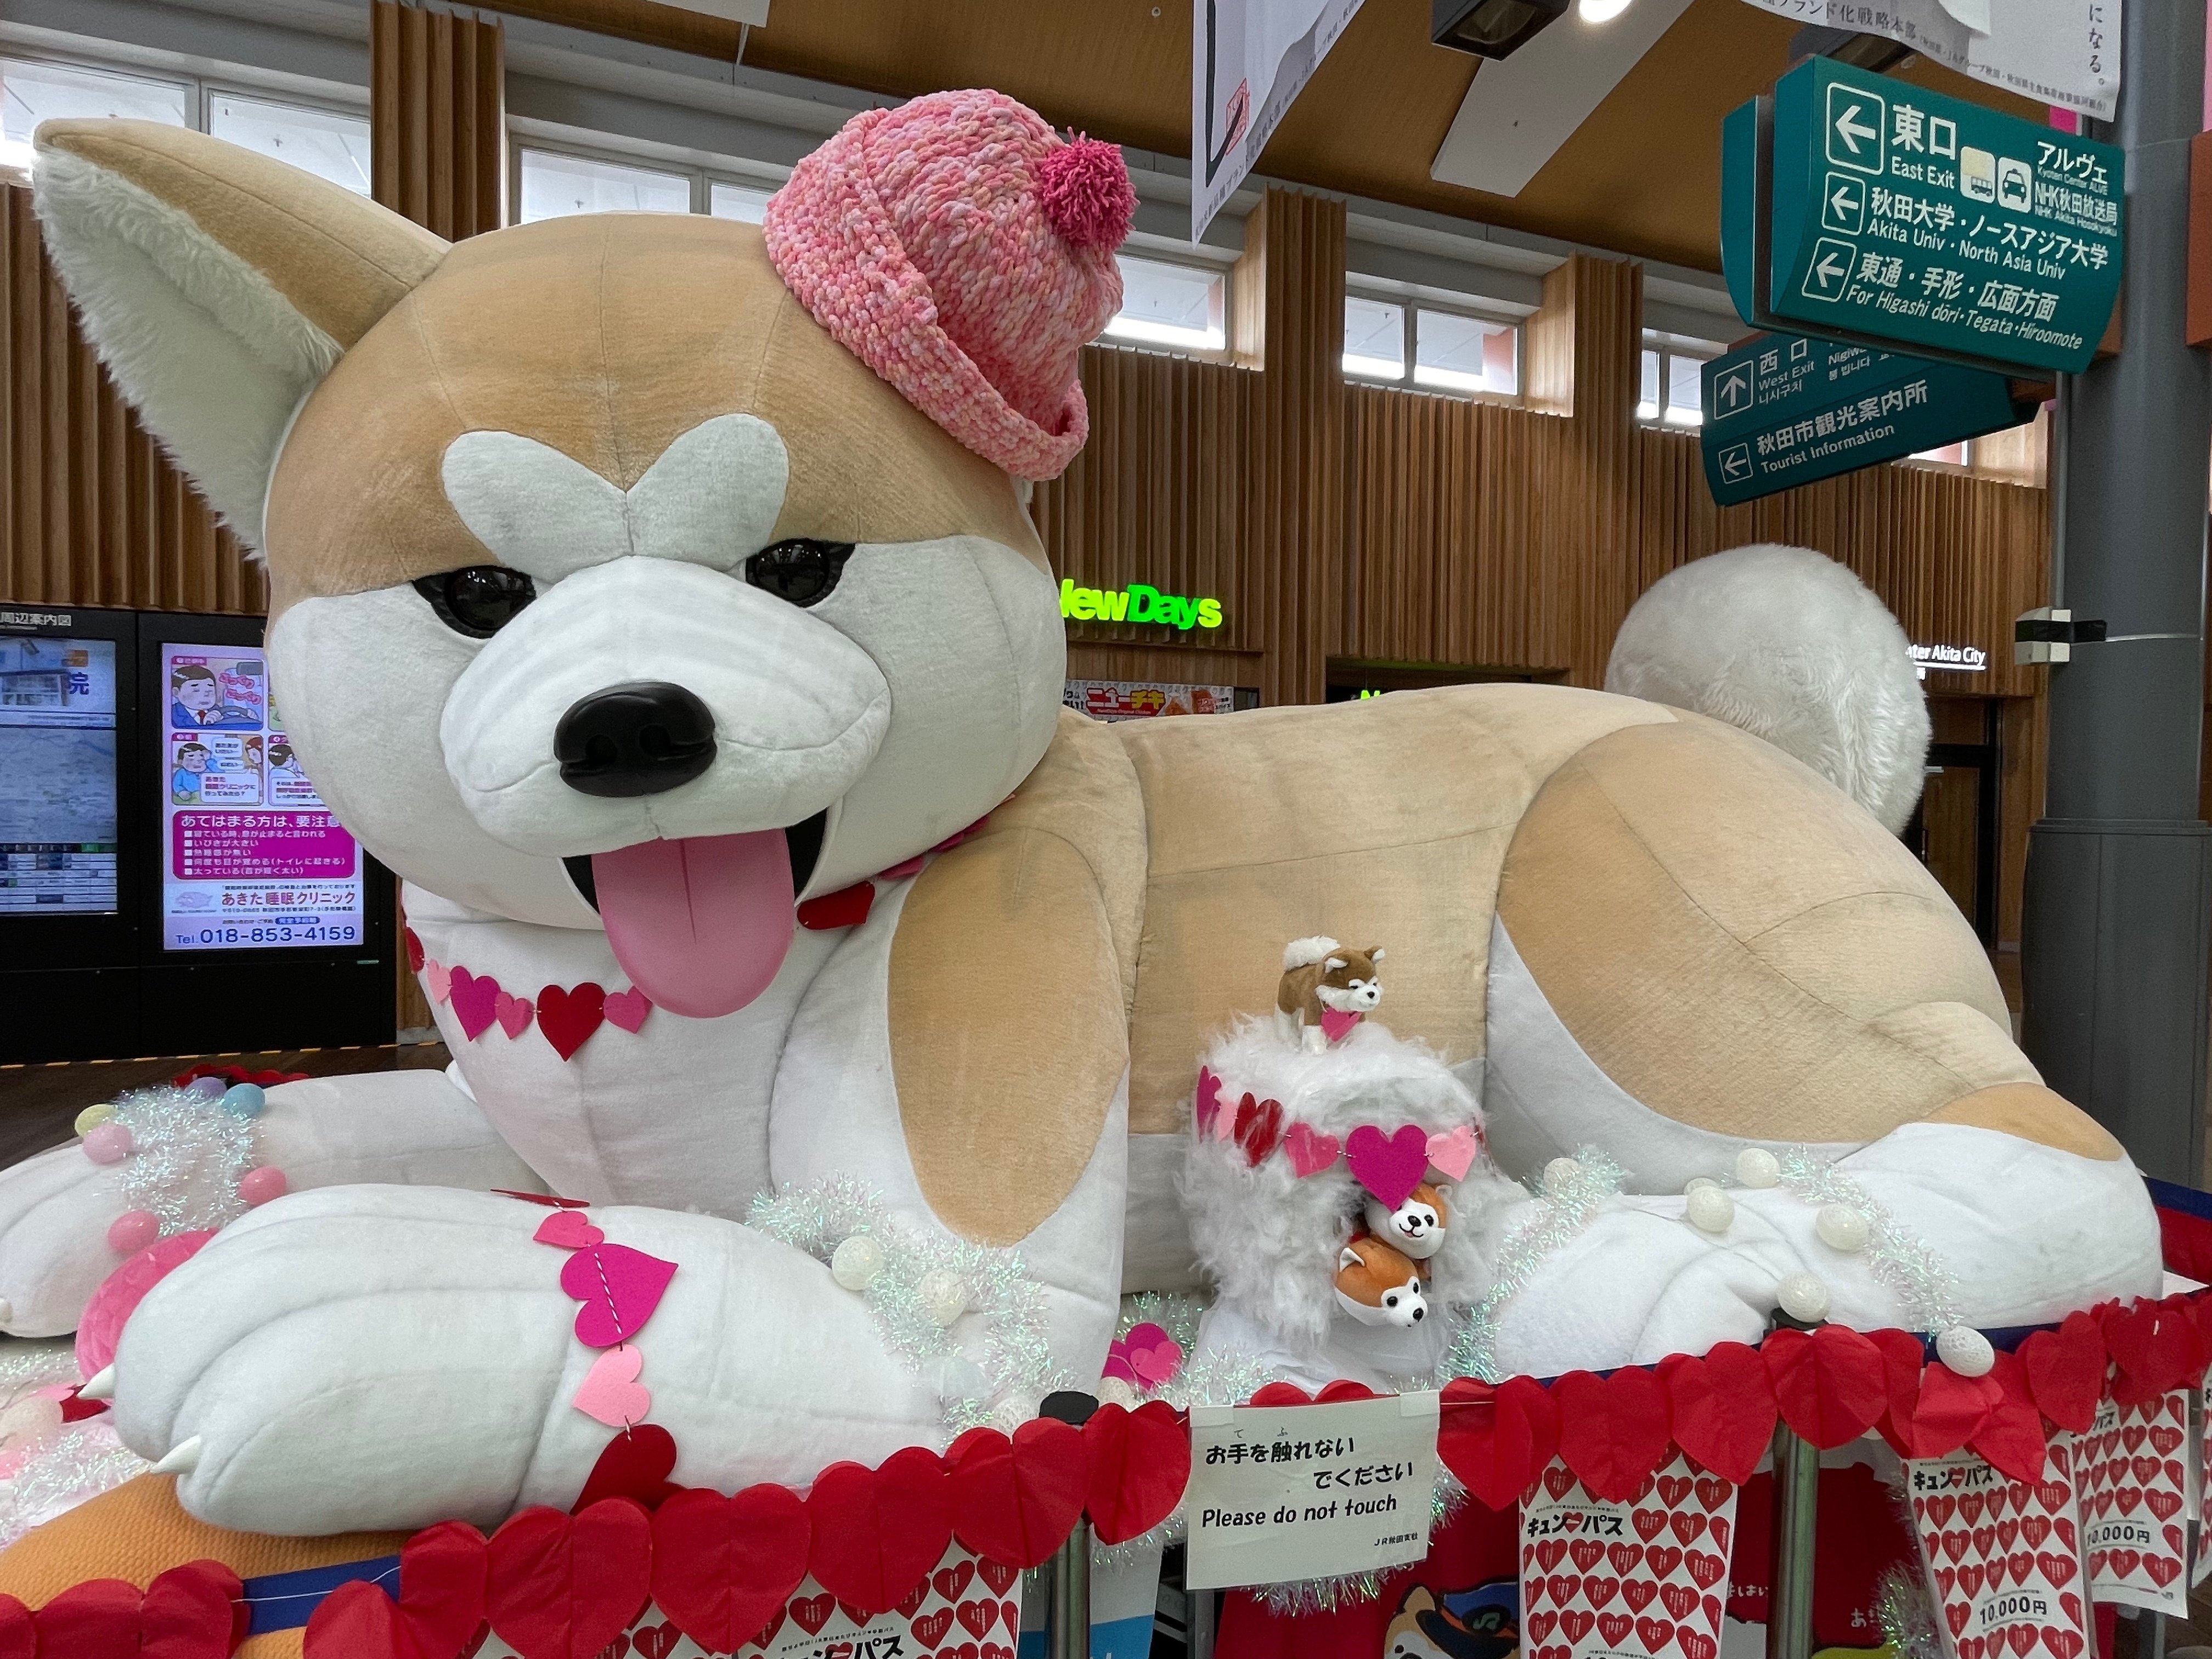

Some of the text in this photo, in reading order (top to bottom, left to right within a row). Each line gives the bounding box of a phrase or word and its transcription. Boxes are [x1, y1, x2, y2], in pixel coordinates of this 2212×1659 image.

[1891, 104, 1956, 160] 東口
[1892, 156, 1955, 189] East Exit
[2038, 141, 2108, 184] アルヴェ
[2035, 181, 2118, 225] NHK秋田放送局
[1867, 218, 2066, 280] Akita Univ North Asia Univ
[1846, 284, 1873, 302] For
[1876, 290, 1930, 318] Higashi
[1759, 360, 1815, 391] West Exit
[1757, 379, 1927, 455] 秋田市観光案内所
[1760, 424, 1895, 473] Tourist Information
[1932, 644, 1961, 662] Akita
[1962, 647, 1986, 667] City
[200, 926, 356, 944] 018-853-4159
[1206, 1437, 1355, 1465] お手を触れない
[1313, 1462, 1413, 1489] でください
[1202, 1493, 1397, 1528] Please do not touch
